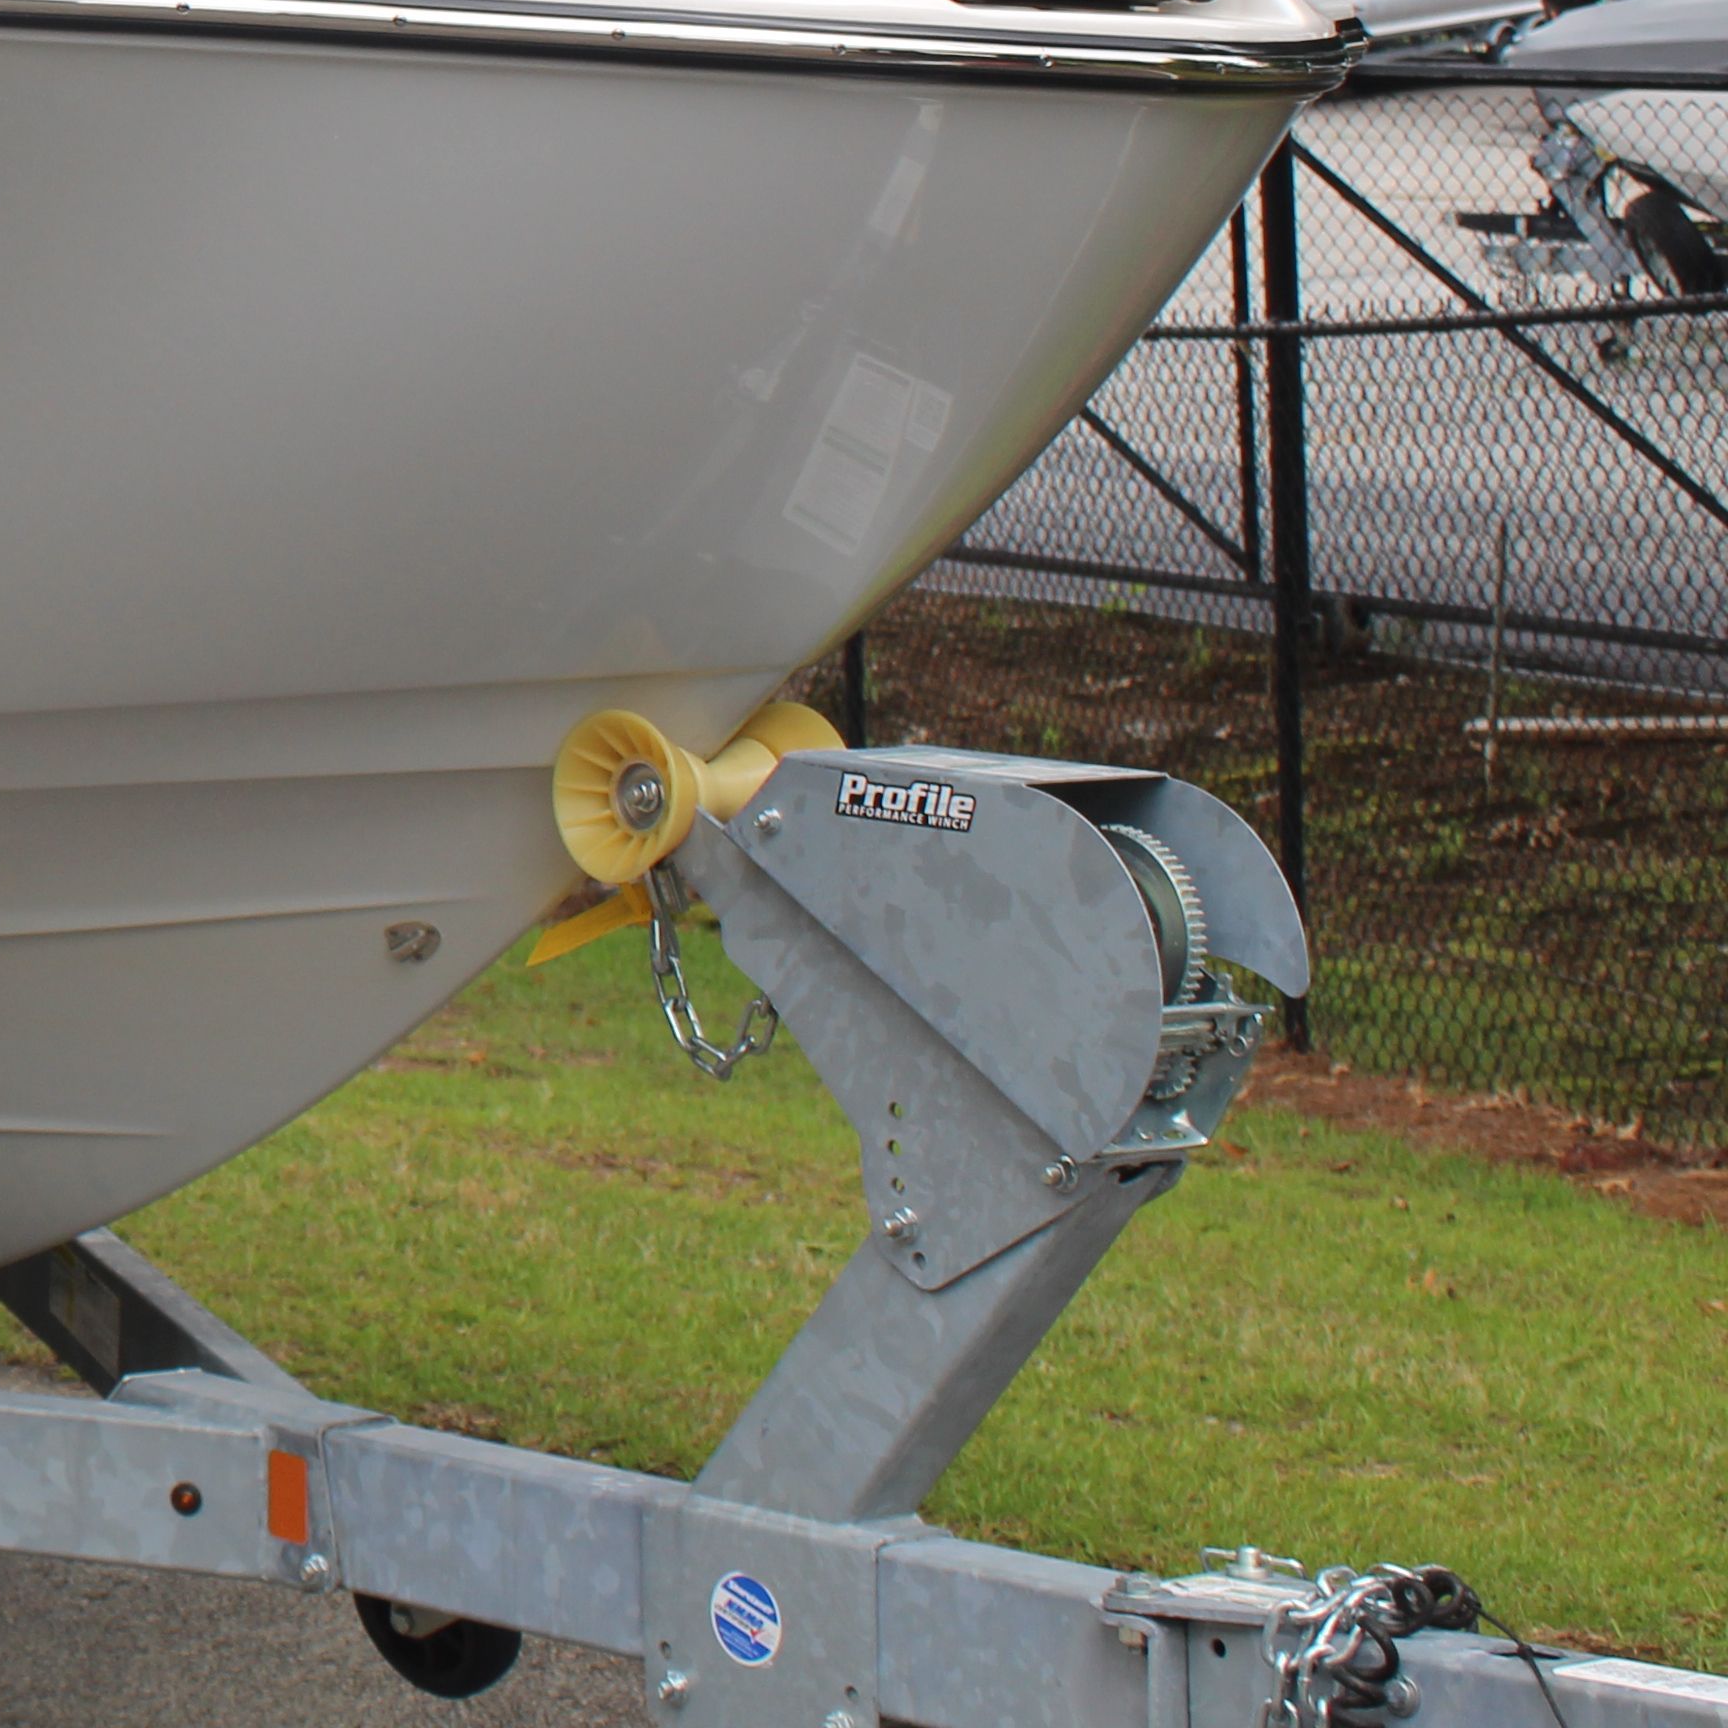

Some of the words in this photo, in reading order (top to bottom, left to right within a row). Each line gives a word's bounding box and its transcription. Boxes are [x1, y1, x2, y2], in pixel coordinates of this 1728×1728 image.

[839, 772, 975, 820] Profile
[838, 803, 923, 825] PERFORMANCE
[927, 815, 969, 831] WINCH
